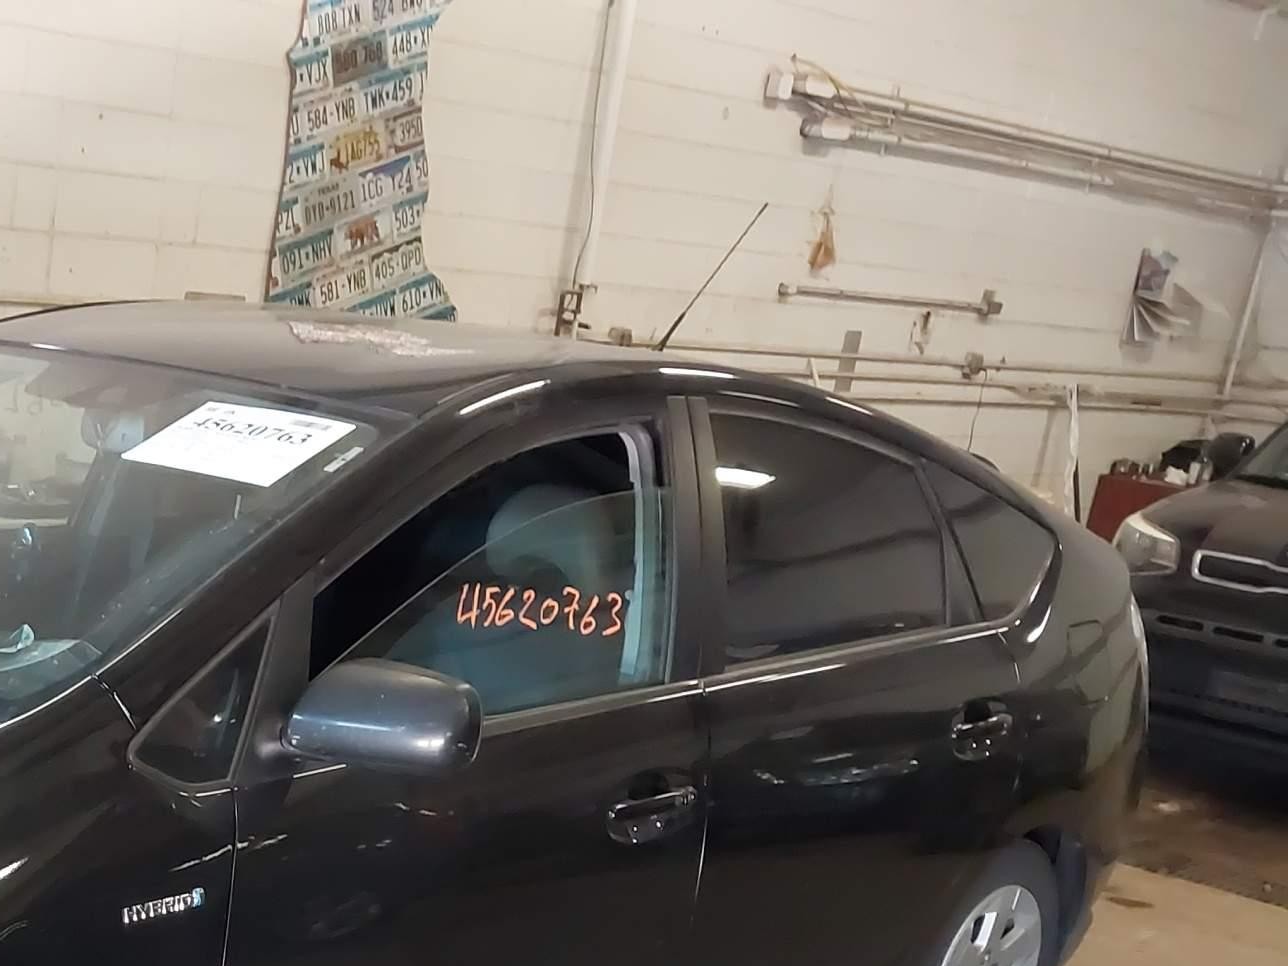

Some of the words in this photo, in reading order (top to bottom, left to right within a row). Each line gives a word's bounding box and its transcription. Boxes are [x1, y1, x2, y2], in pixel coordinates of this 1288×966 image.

[192, 417, 313, 446] 45620763
[456, 582, 623, 636] 45620763
[122, 892, 193, 924] HYBRID
